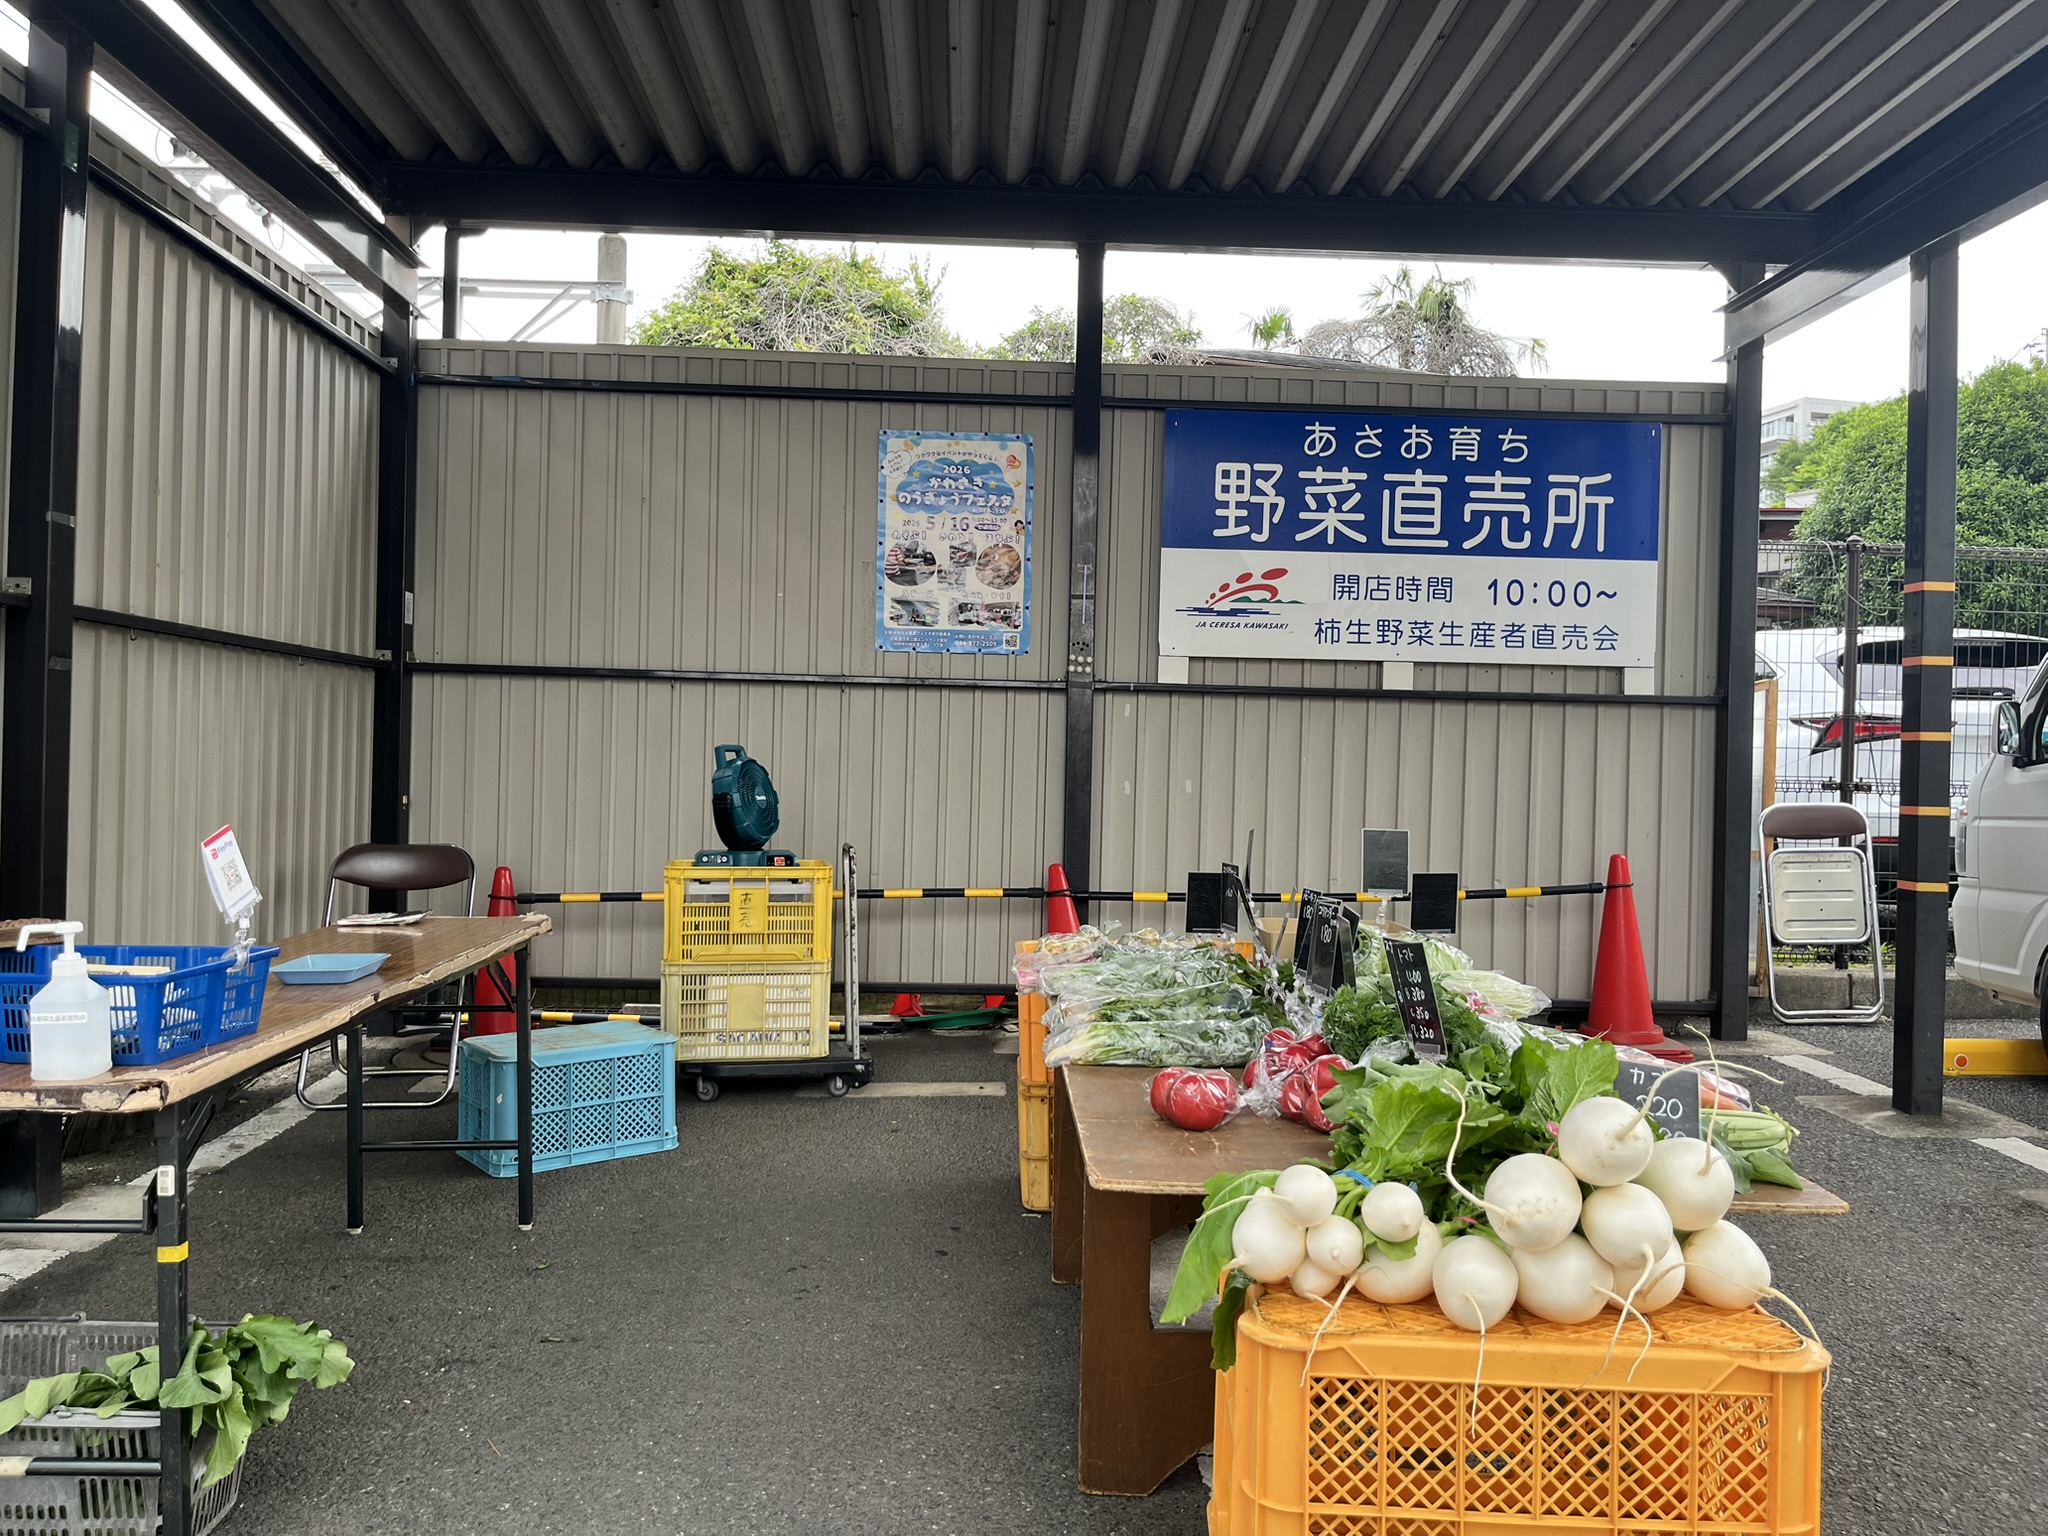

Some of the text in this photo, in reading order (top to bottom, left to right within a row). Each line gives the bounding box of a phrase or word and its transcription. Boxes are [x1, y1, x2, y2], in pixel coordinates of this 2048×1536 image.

[1303, 421, 1529, 463] あさお育ち
[943, 465, 971, 474] 2026
[929, 477, 984, 490] かわさき
[898, 491, 1012, 507] のうぎょうフェスタ
[1212, 462, 1615, 553] 野菜直売所
[902, 519, 921, 527] 2026
[1332, 573, 1454, 604] 開店時間
[1209, 621, 1241, 629] CERESA
[1243, 622, 1289, 630] KAWASAKI
[1314, 617, 1620, 652] 柿生野菜生産者直売会
[1321, 924, 1332, 943] 180
[1397, 947, 1414, 963] トマト
[1405, 969, 1422, 985] 400
[1411, 986, 1425, 1001] 380
[1415, 1006, 1430, 1020] 350
[1420, 1025, 1435, 1039] 320
